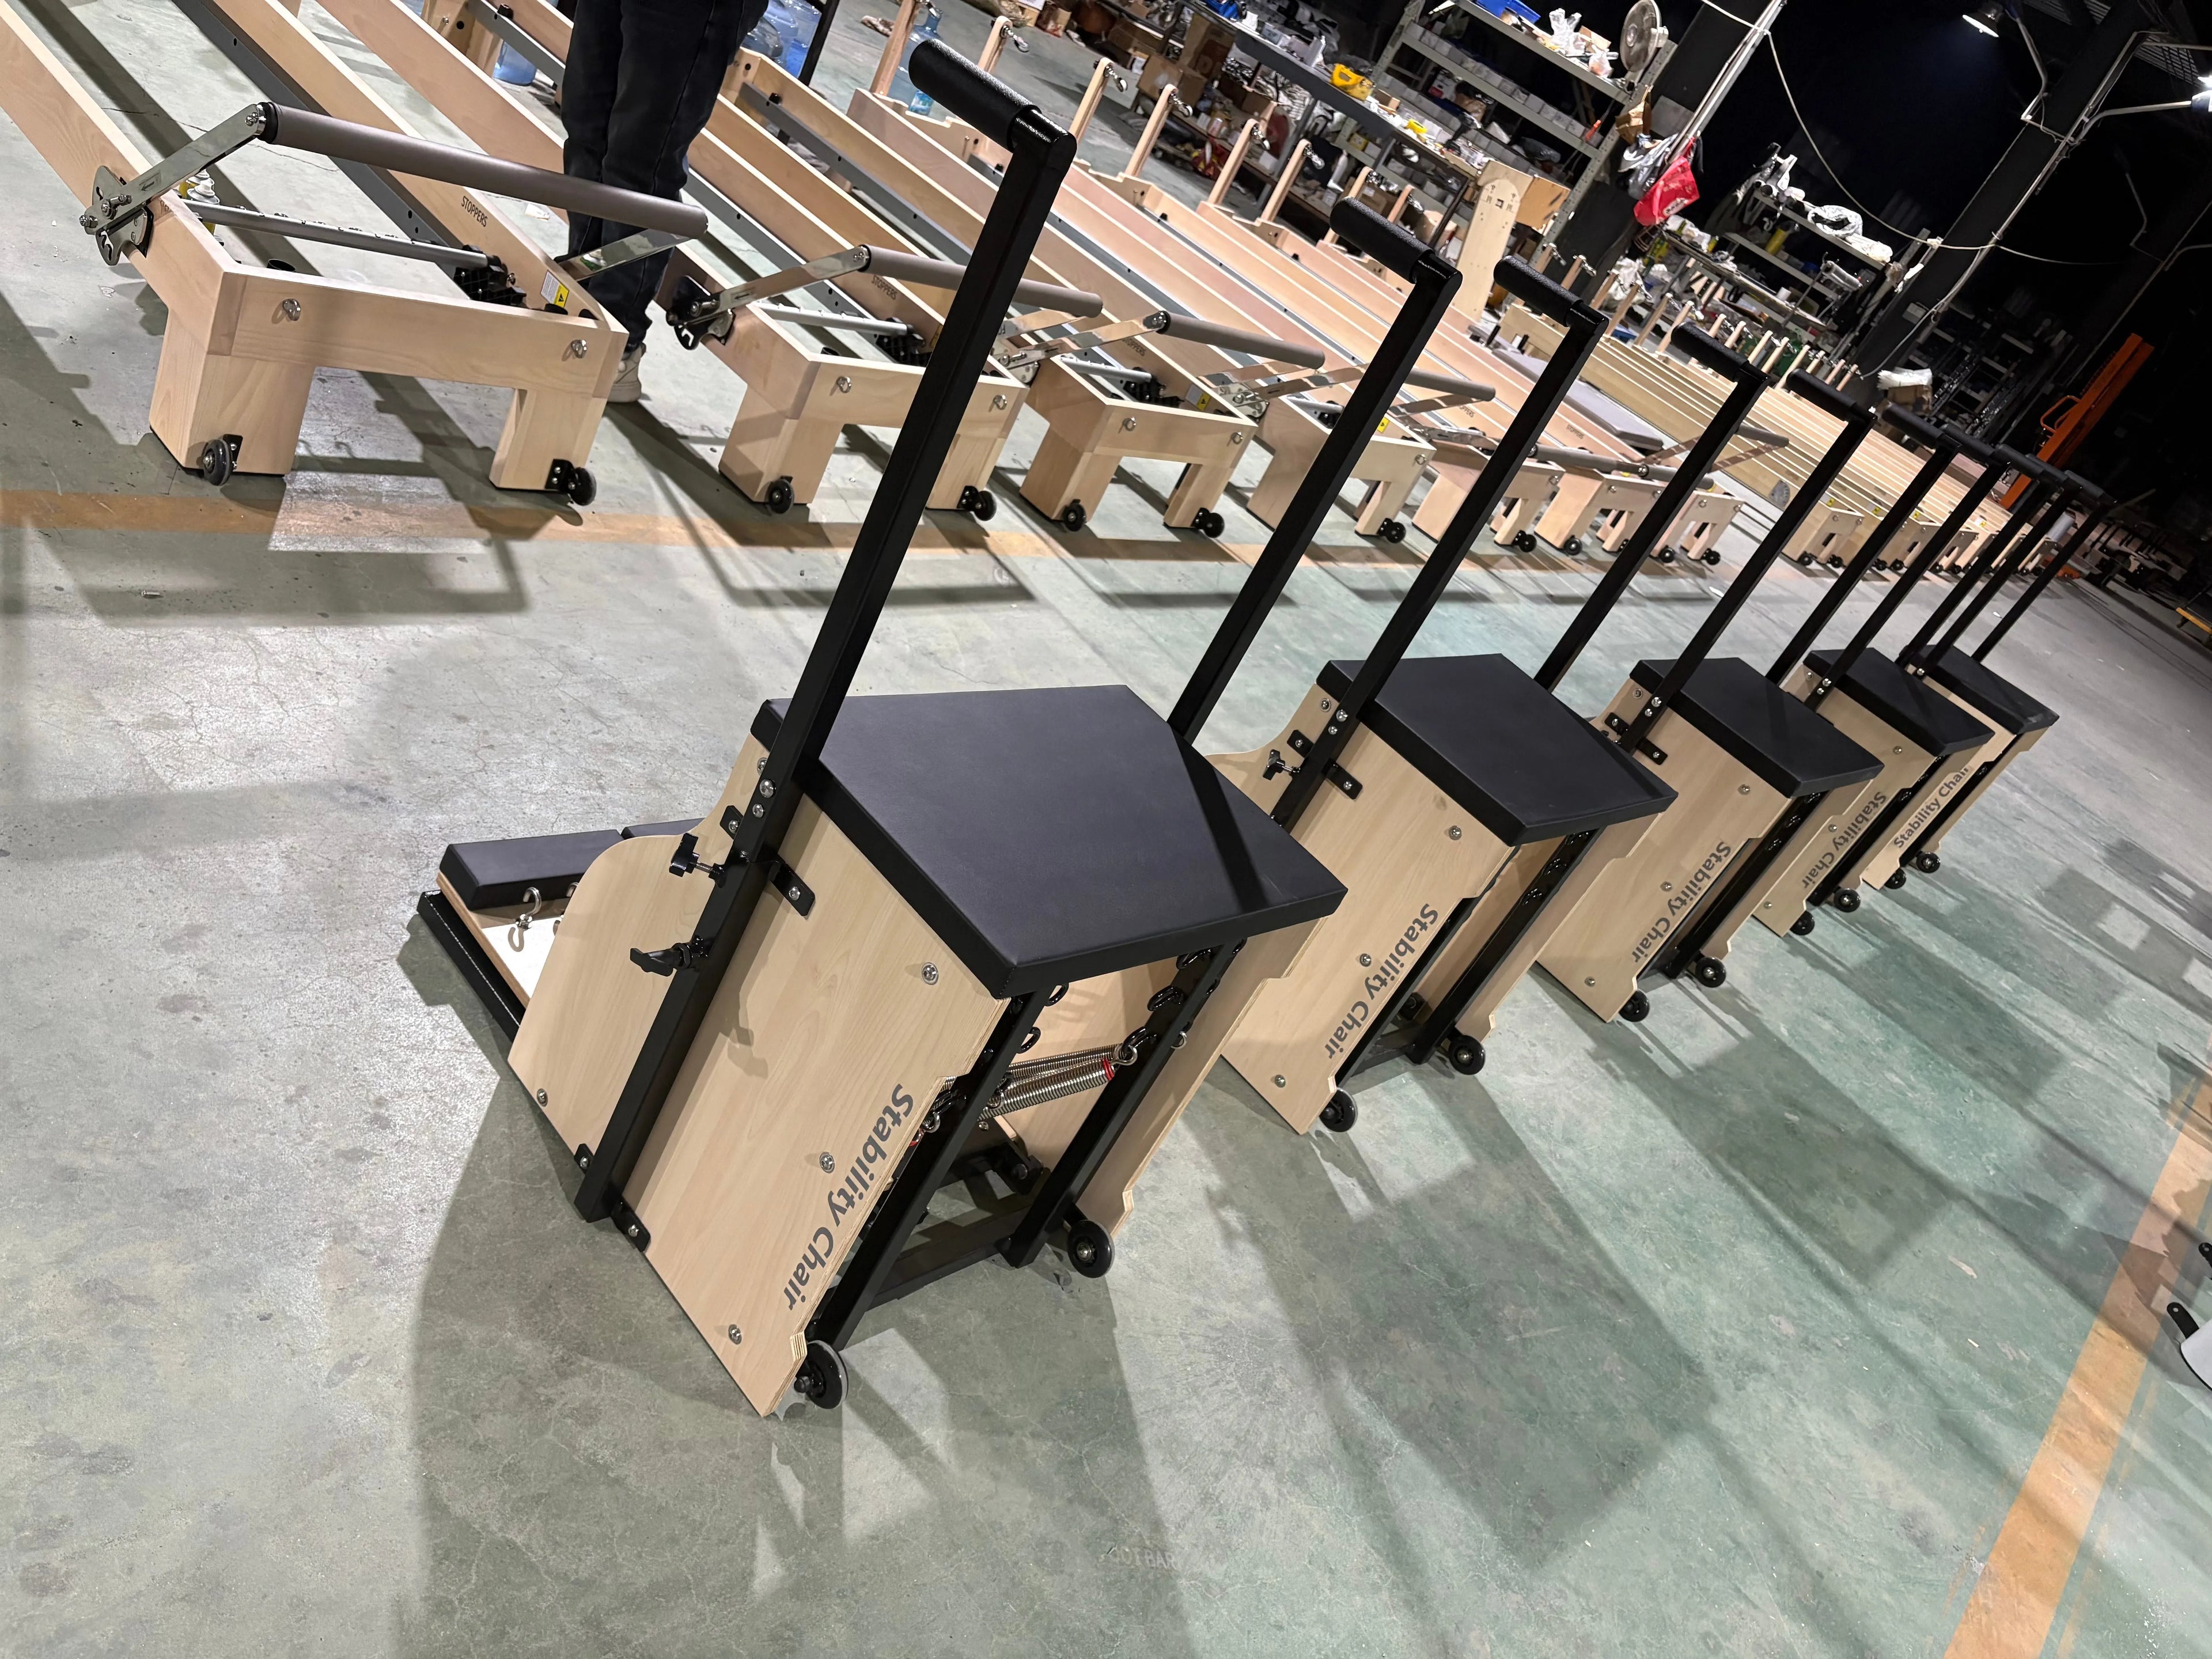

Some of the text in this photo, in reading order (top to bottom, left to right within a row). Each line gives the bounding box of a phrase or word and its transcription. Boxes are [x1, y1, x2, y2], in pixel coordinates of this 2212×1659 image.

[461, 195, 488, 227] STOPPERS
[871, 275, 897, 300] STOPPERS
[1801, 791, 1887, 889] Stability Chair
[1893, 798, 1941, 848] Stability
[1631, 841, 1732, 963] Stability Chair
[1324, 903, 1438, 1059] Stability Chair
[783, 1084, 914, 1311] Stability Chair
